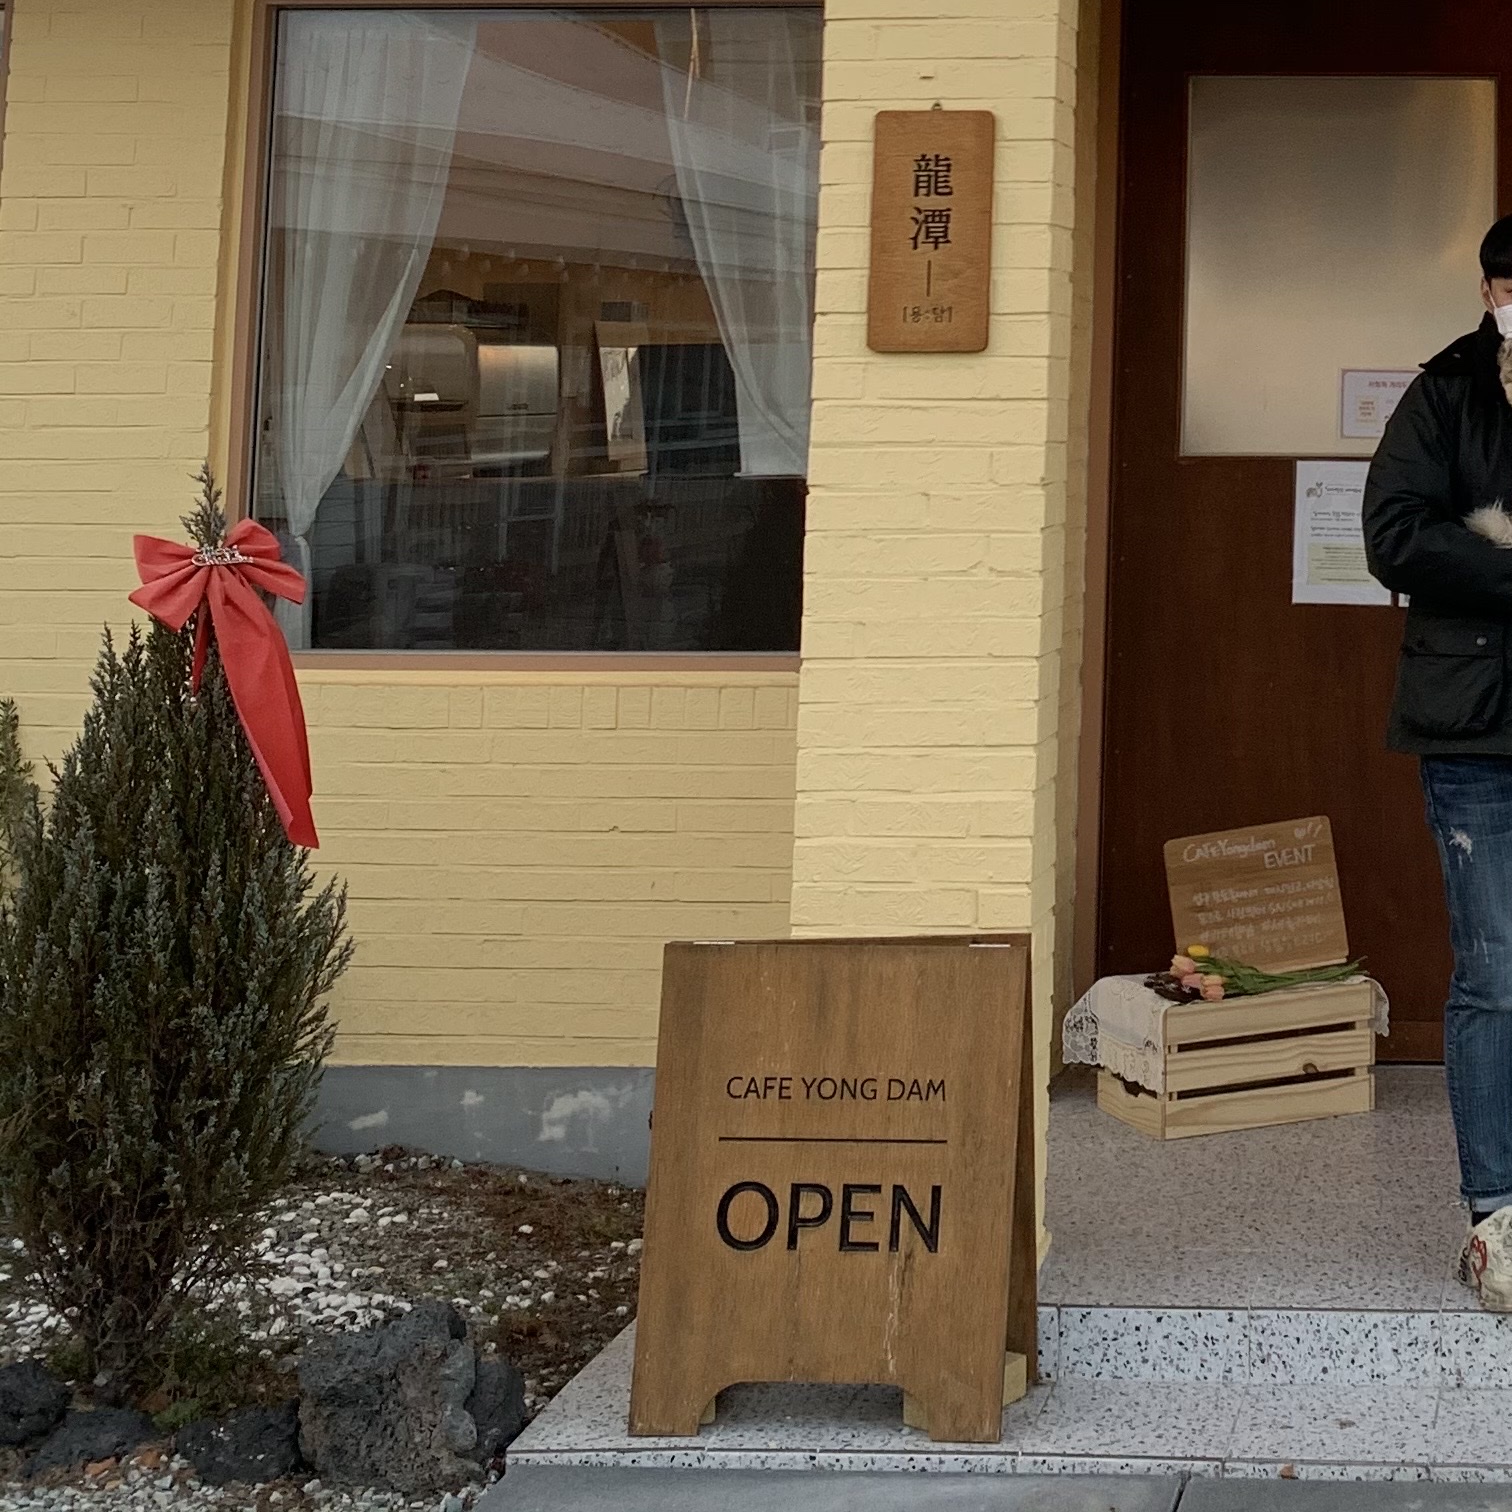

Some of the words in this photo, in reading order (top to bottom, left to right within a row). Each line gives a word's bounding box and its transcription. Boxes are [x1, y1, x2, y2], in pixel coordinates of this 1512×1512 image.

[908, 153, 953, 251] 龍潭
[1264, 844, 1316, 869] EVENT
[726, 1076, 792, 1100] CAFE
[802, 1077, 878, 1101] YONG
[887, 1078, 946, 1102] DAM
[716, 1180, 942, 1254] OPEN
